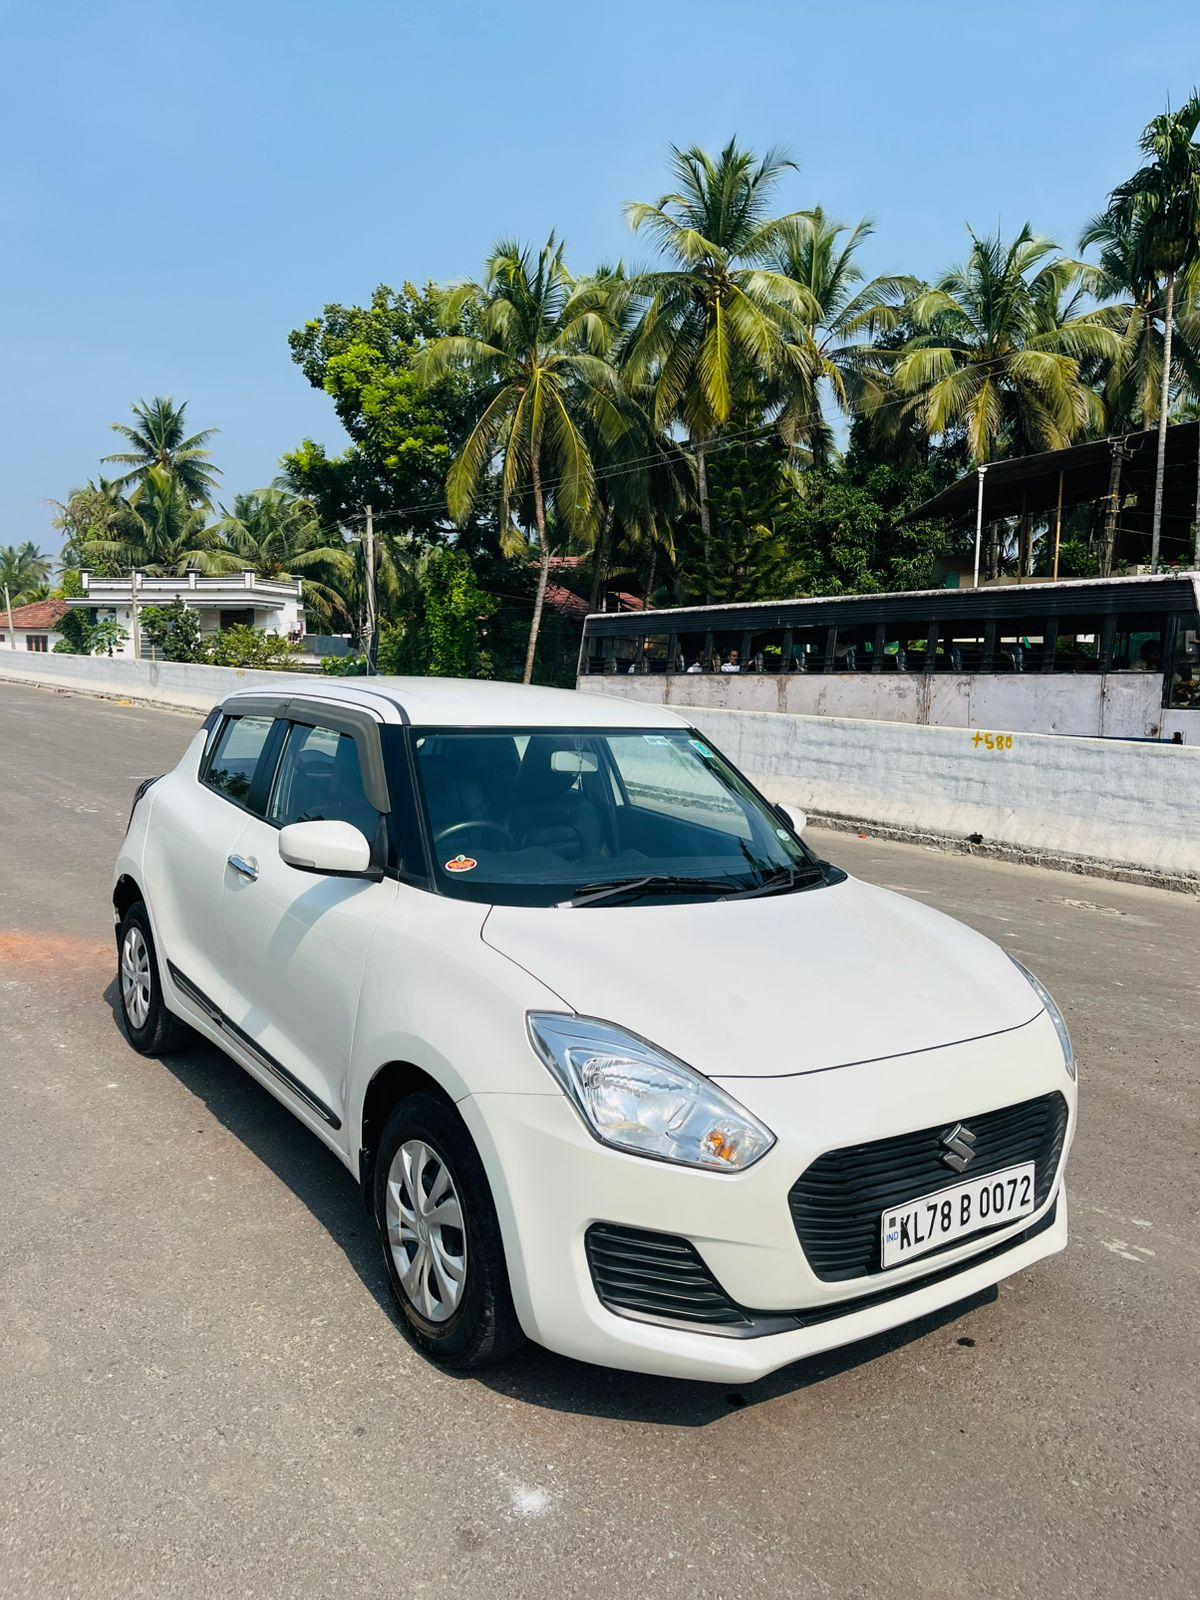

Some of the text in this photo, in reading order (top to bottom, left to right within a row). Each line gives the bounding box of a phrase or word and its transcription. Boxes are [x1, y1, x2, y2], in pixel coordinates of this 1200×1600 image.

[899, 1174, 1031, 1251] KL78 B 0072
[886, 1231, 899, 1243] IND
